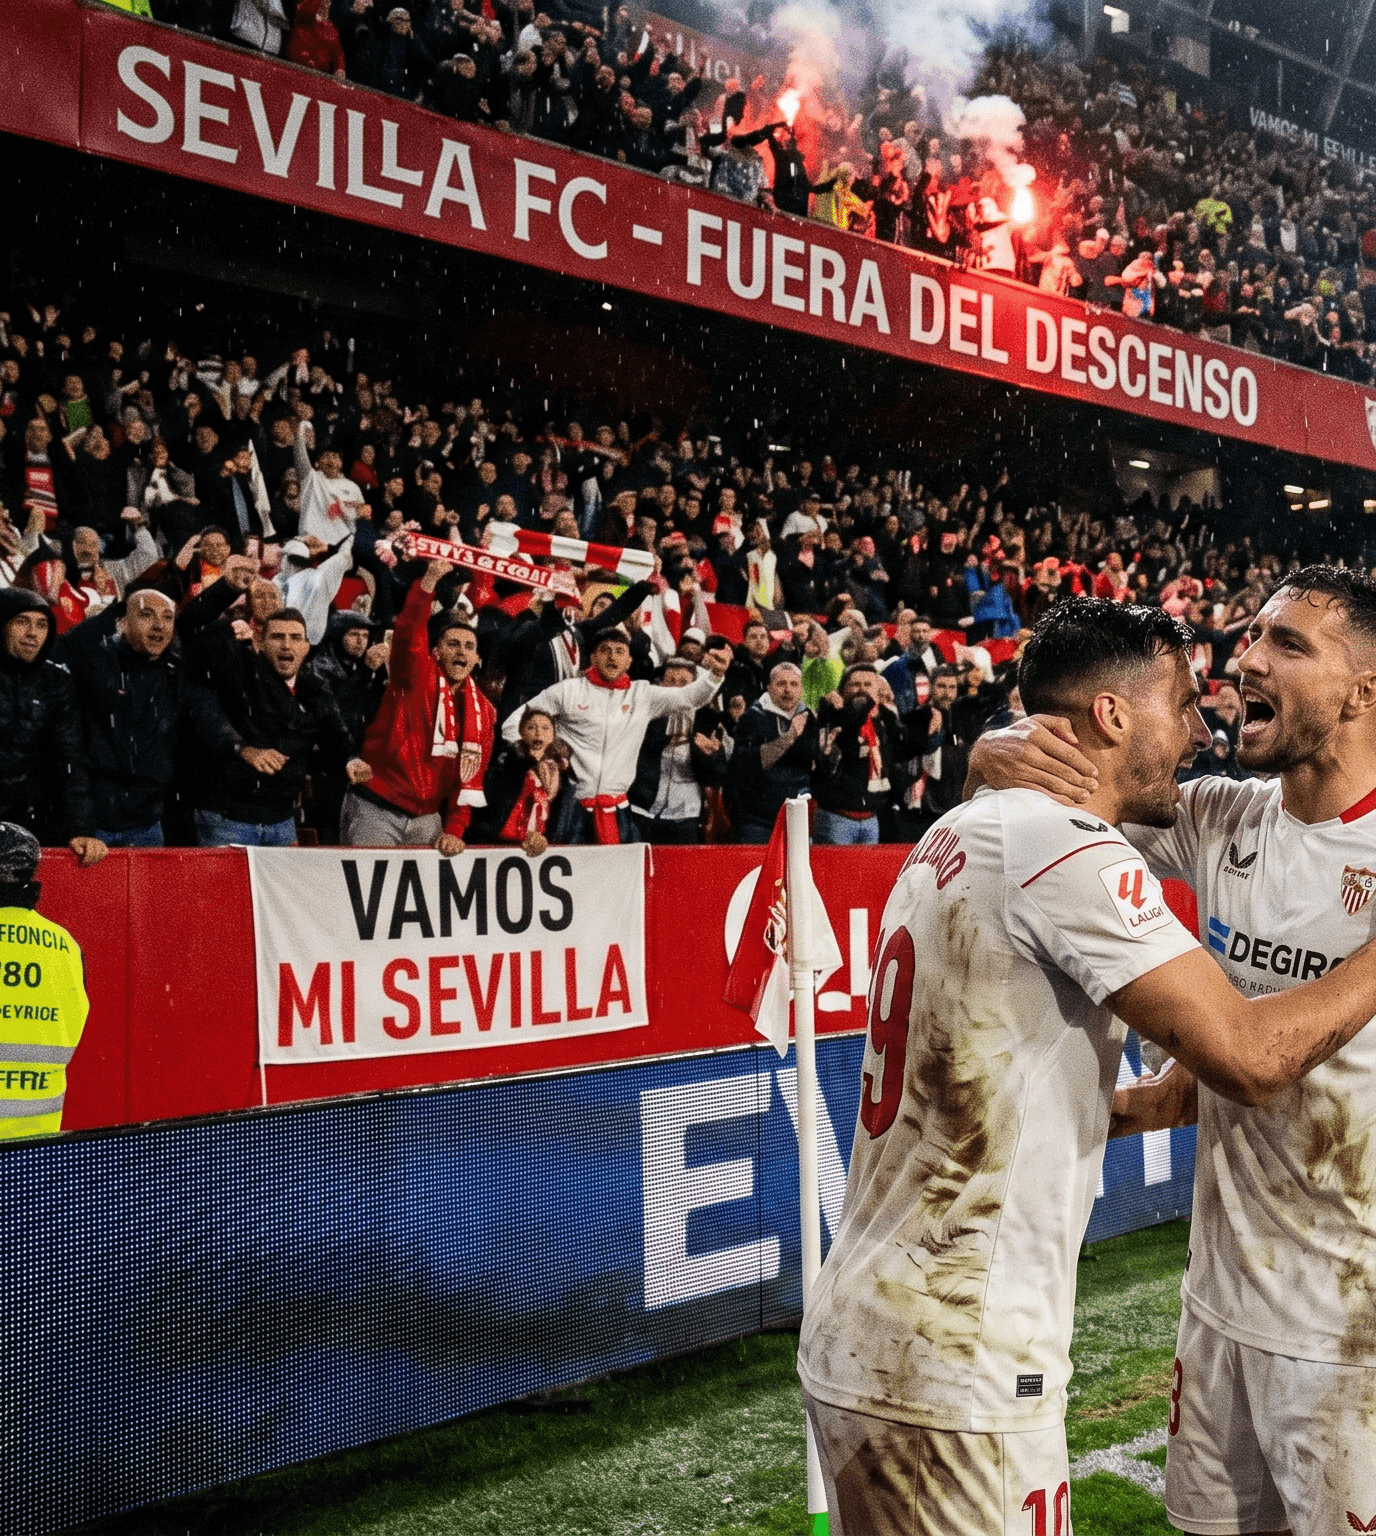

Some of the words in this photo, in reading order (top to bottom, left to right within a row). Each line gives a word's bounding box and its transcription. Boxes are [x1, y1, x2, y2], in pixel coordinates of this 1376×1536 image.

[117, 45, 487, 230] SEVILLA
[513, 157, 608, 260] FC
[633, 223, 663, 246] -
[686, 208, 891, 334] FUERA
[909, 272, 1009, 365] DEL
[1026, 307, 1259, 427] DESCENSO
[341, 855, 574, 941] VAMOS
[277, 960, 357, 1048] MI
[381, 943, 633, 1041] SEVILLA
